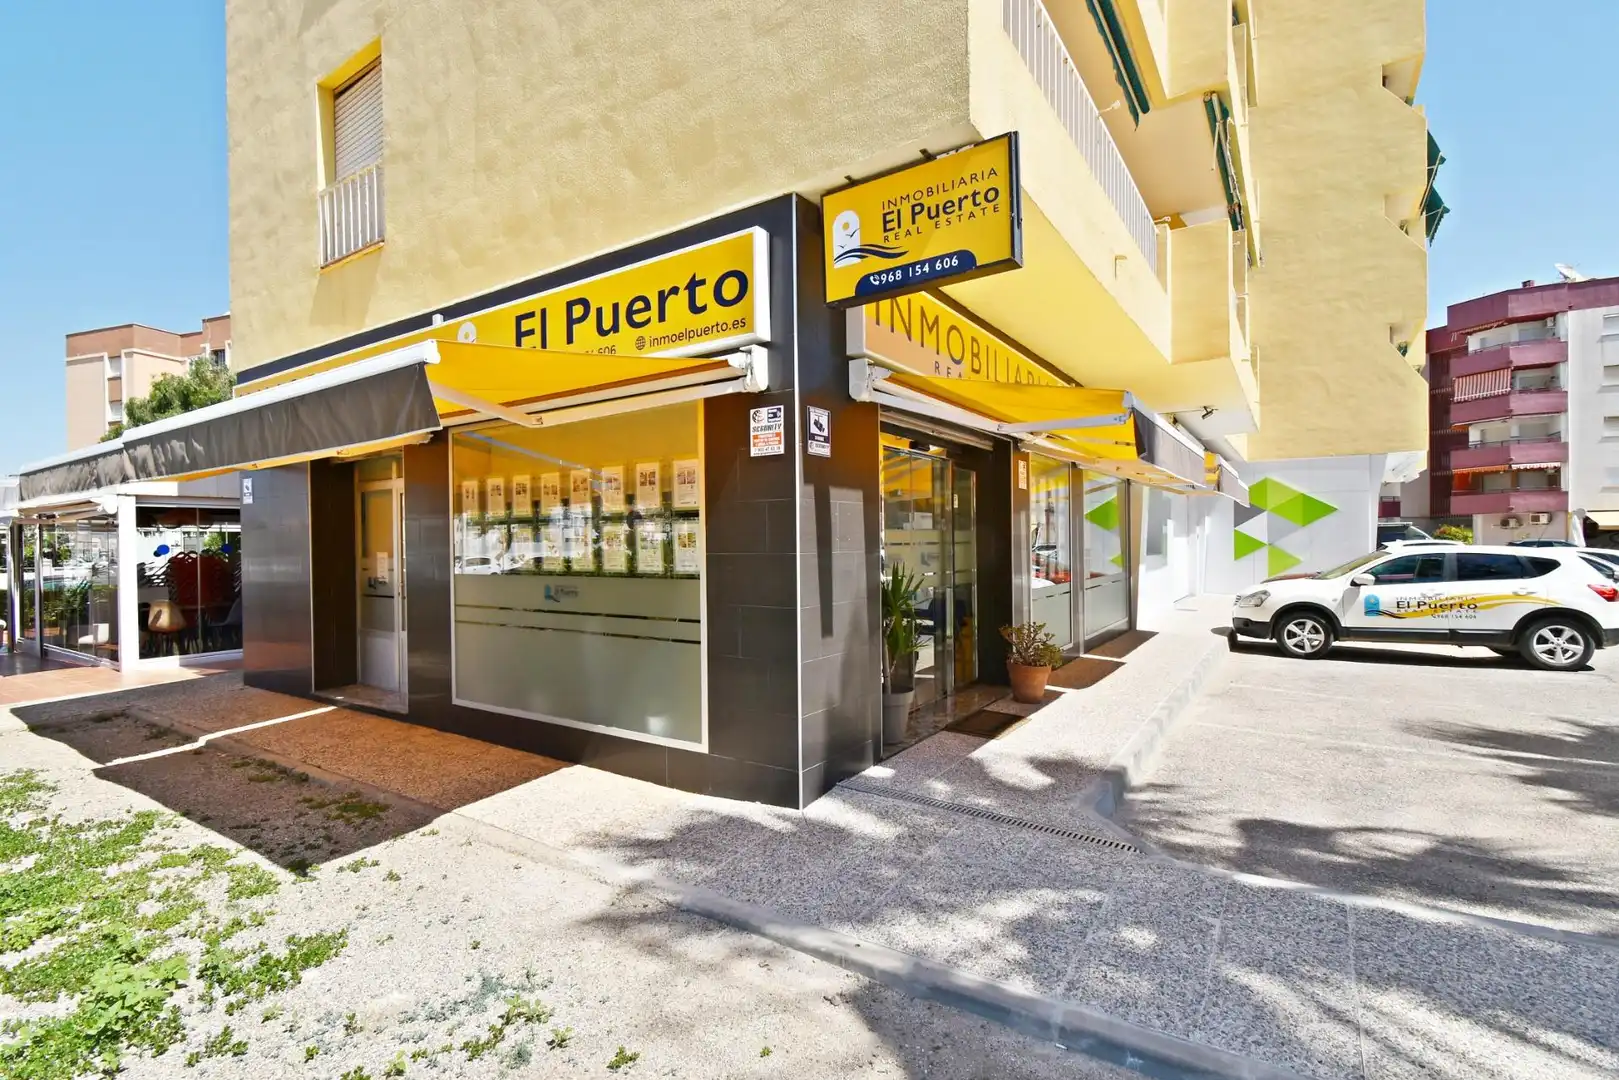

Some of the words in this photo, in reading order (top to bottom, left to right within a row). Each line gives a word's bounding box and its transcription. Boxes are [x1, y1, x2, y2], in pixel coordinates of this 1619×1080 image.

[882, 167, 999, 211] INMOBILIARIA
[882, 208, 902, 233] El
[910, 186, 1000, 226] Puerto
[883, 226, 923, 243] REAL
[934, 203, 1000, 230] ESTATE
[880, 269, 903, 284] 968
[909, 262, 930, 277] 154
[935, 254, 959, 271] 606
[514, 307, 548, 350] El
[565, 269, 749, 346] Puerto
[648, 317, 747, 349] inmoelpuerto.es
[1396, 600, 1410, 609] El
[1417, 601, 1478, 609] Puerto
